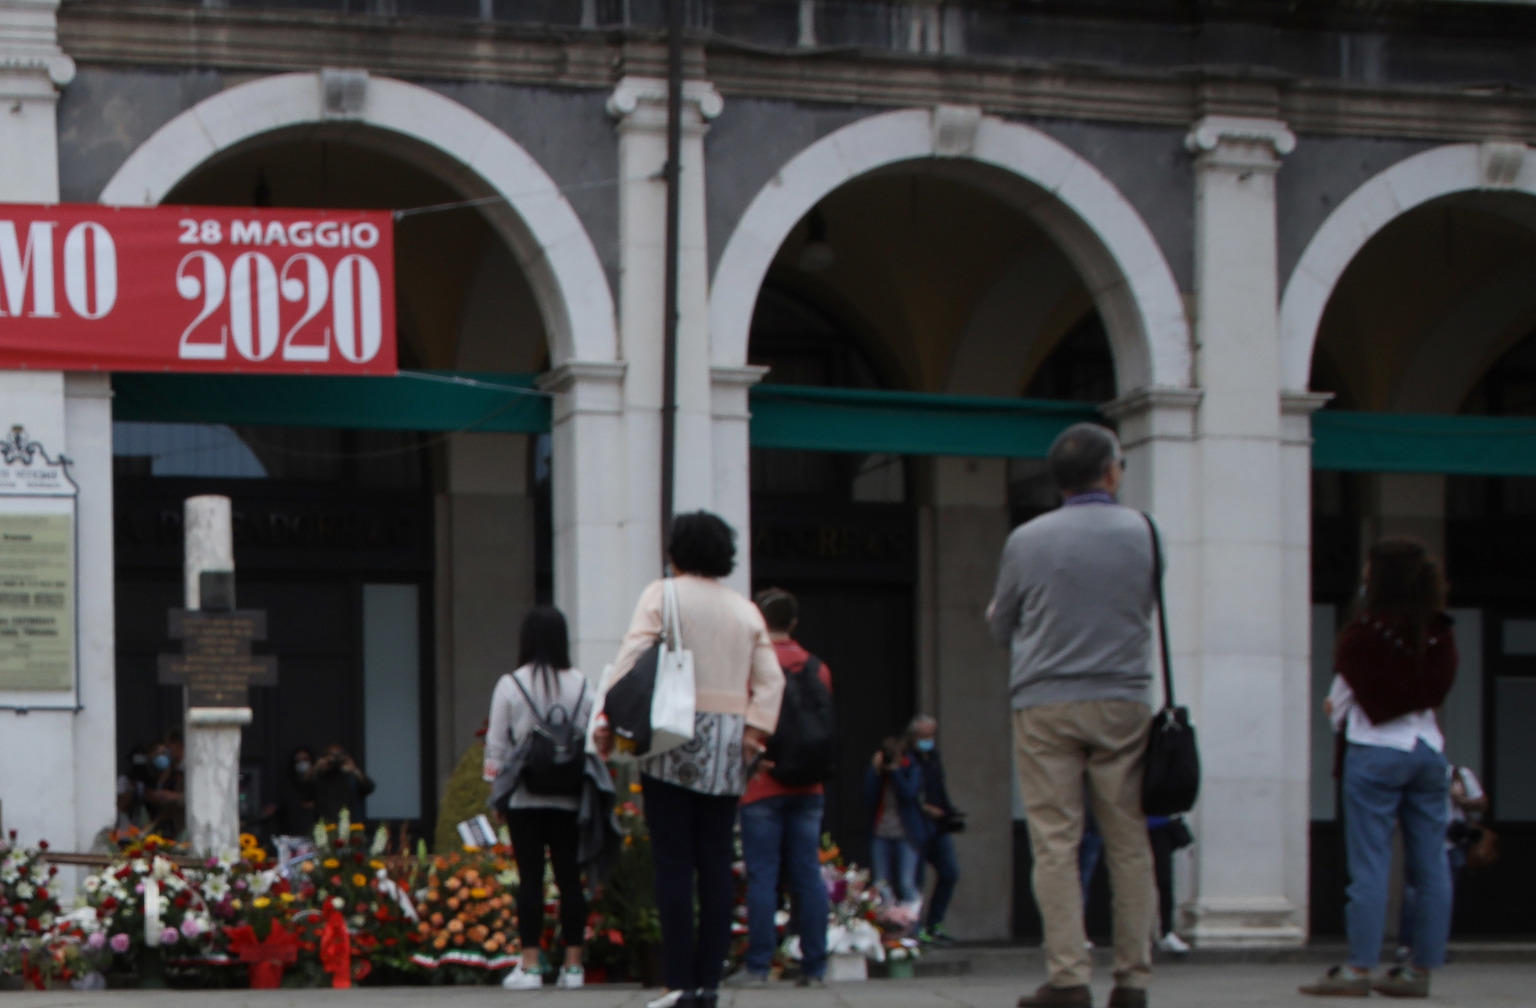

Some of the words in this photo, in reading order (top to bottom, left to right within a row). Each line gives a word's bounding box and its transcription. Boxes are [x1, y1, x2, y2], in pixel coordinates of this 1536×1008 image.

[177, 218, 223, 244] 28
[230, 220, 380, 249] MAGGIO
[175, 250, 383, 364] 2020
